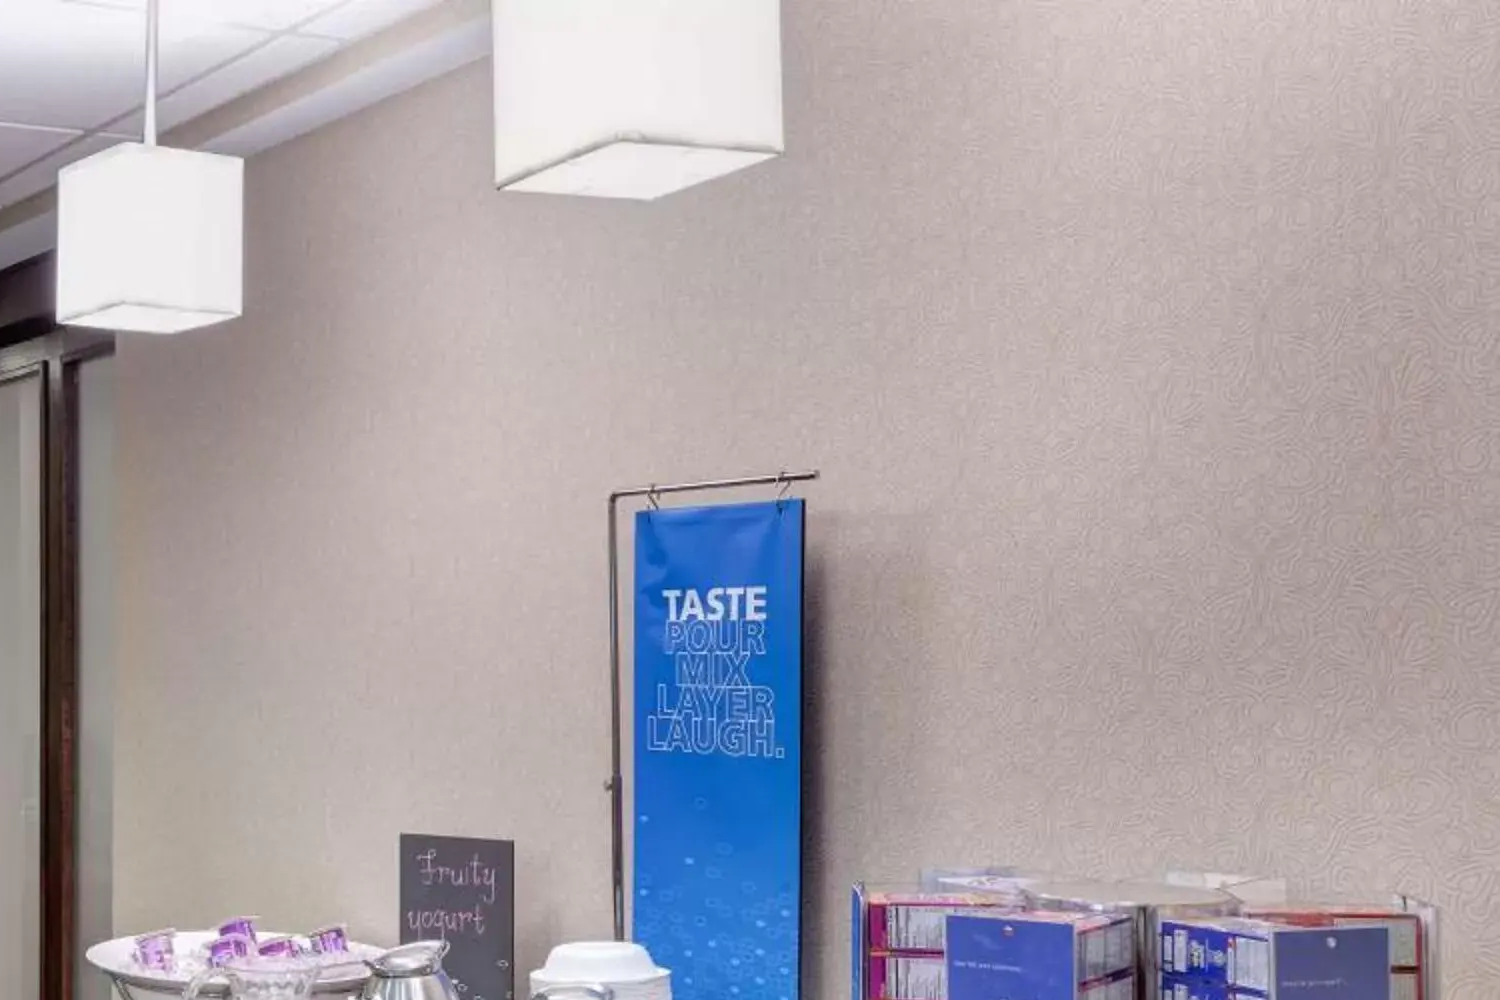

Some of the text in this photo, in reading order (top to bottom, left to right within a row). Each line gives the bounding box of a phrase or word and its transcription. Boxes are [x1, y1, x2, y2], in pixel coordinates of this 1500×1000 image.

[661, 585, 767, 621] TASTE
[664, 619, 767, 655] POUR
[675, 651, 751, 688] MIX
[657, 683, 776, 723] LAYER
[647, 715, 785, 758] LAUGH.
[415, 848, 496, 904] Fruity
[407, 904, 485, 942] yogurt
